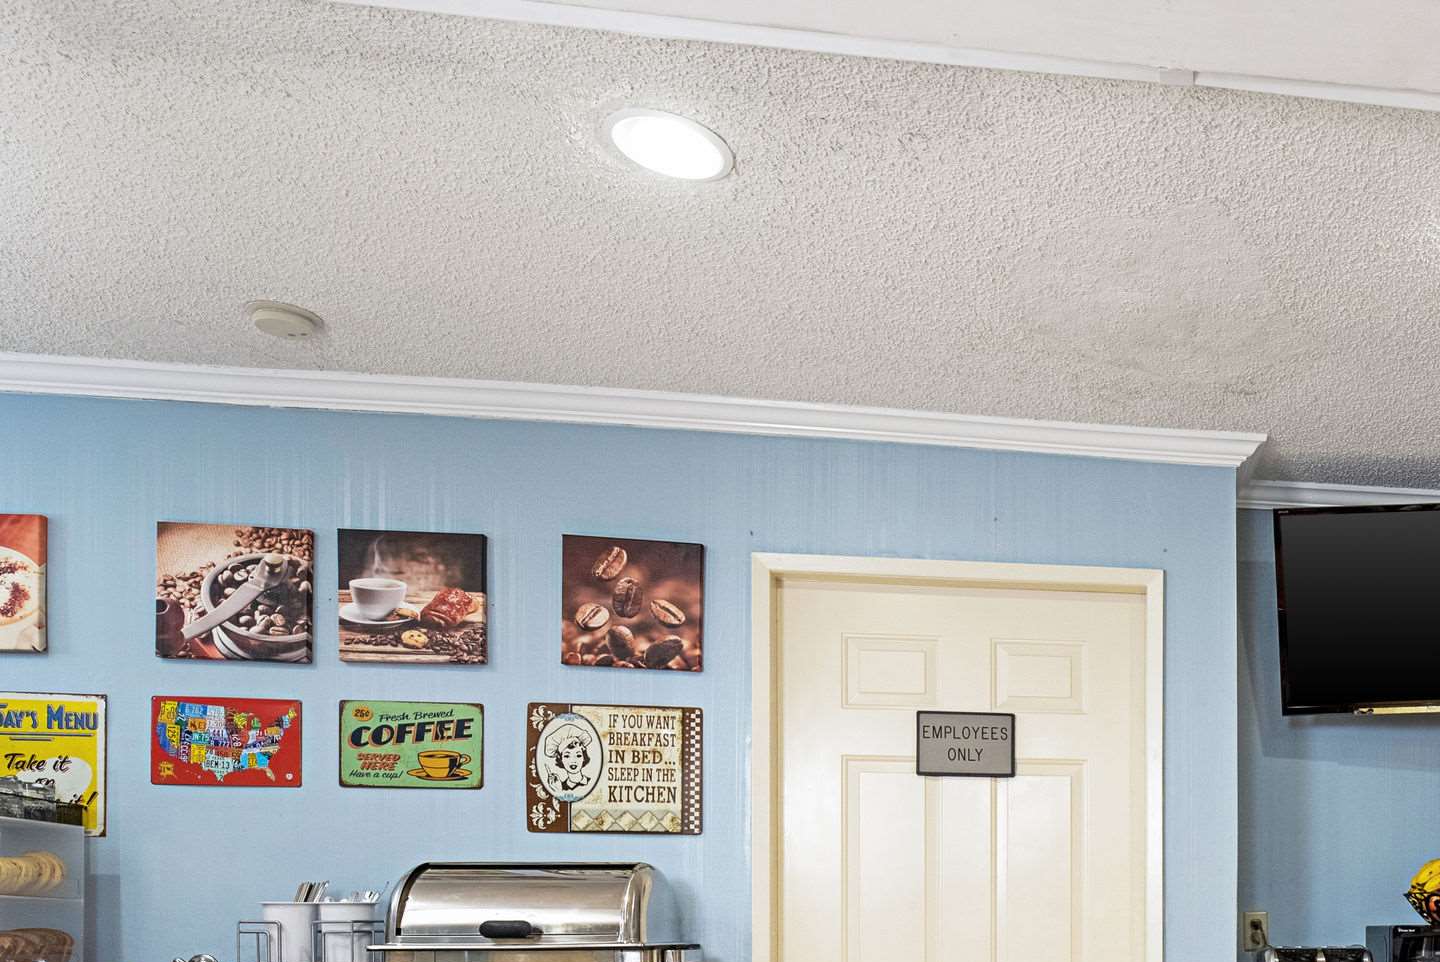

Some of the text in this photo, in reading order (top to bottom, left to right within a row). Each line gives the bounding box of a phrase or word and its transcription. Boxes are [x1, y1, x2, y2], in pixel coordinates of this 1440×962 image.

[0, 703, 38, 729] AY'S
[379, 709, 455, 722] Fresh Brewed
[608, 714, 677, 730] IF YOU WANT
[349, 718, 474, 749] COFFEE
[608, 732, 677, 747] BREAKFAST
[922, 725, 1008, 740] EMPLOYEES
[4, 752, 72, 772] Take it
[356, 752, 400, 762] SERVED
[608, 750, 626, 764] IN
[947, 747, 984, 762] ONLY
[360, 762, 398, 771] HERE
[349, 769, 372, 779] Have
[381, 770, 404, 780] cup!
[608, 767, 676, 783] SLEEP IN THE
[608, 785, 678, 803] KITCHEN
